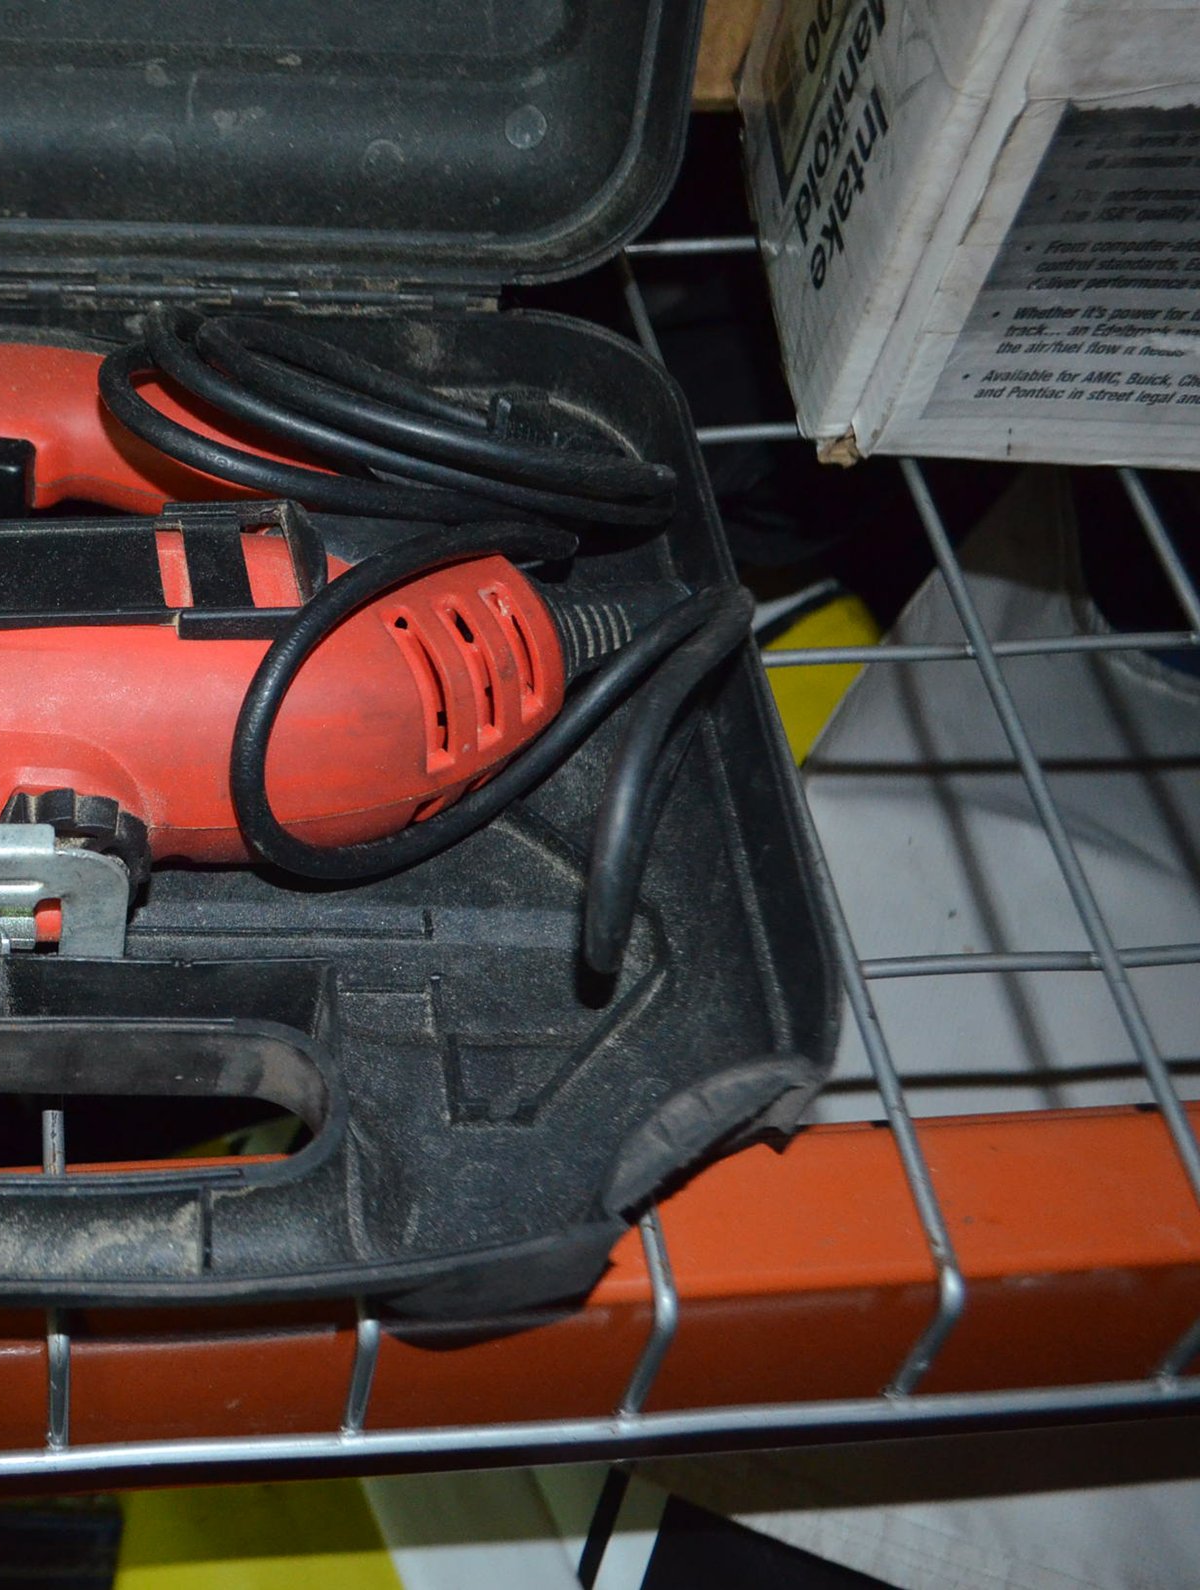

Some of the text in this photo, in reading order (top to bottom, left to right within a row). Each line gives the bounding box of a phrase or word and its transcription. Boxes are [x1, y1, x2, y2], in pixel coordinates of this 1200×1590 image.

[810, 87, 888, 290] Intake
[1043, 240, 1091, 254] From
[1035, 258, 1097, 272] control
[1082, 275, 1189, 292] performance
[1012, 306, 1080, 320] Whether
[1081, 306, 1105, 319] it's
[1107, 308, 1162, 322] power
[1162, 306, 1191, 321] for
[1004, 324, 1061, 337] track...
[1067, 326, 1090, 336] an
[996, 341, 1022, 354] the
[1024, 341, 1084, 354] air/fuel
[1084, 342, 1122, 355] flow
[980, 369, 1053, 383] Available
[1056, 369, 1081, 383] for
[1081, 370, 1121, 386] AMC,
[1126, 372, 1172, 388] Buick,
[974, 387, 1006, 399] and
[1006, 386, 1065, 400] Pontiac
[1067, 388, 1084, 400] in
[1086, 389, 1134, 402] street
[1134, 390, 1175, 405] legal
